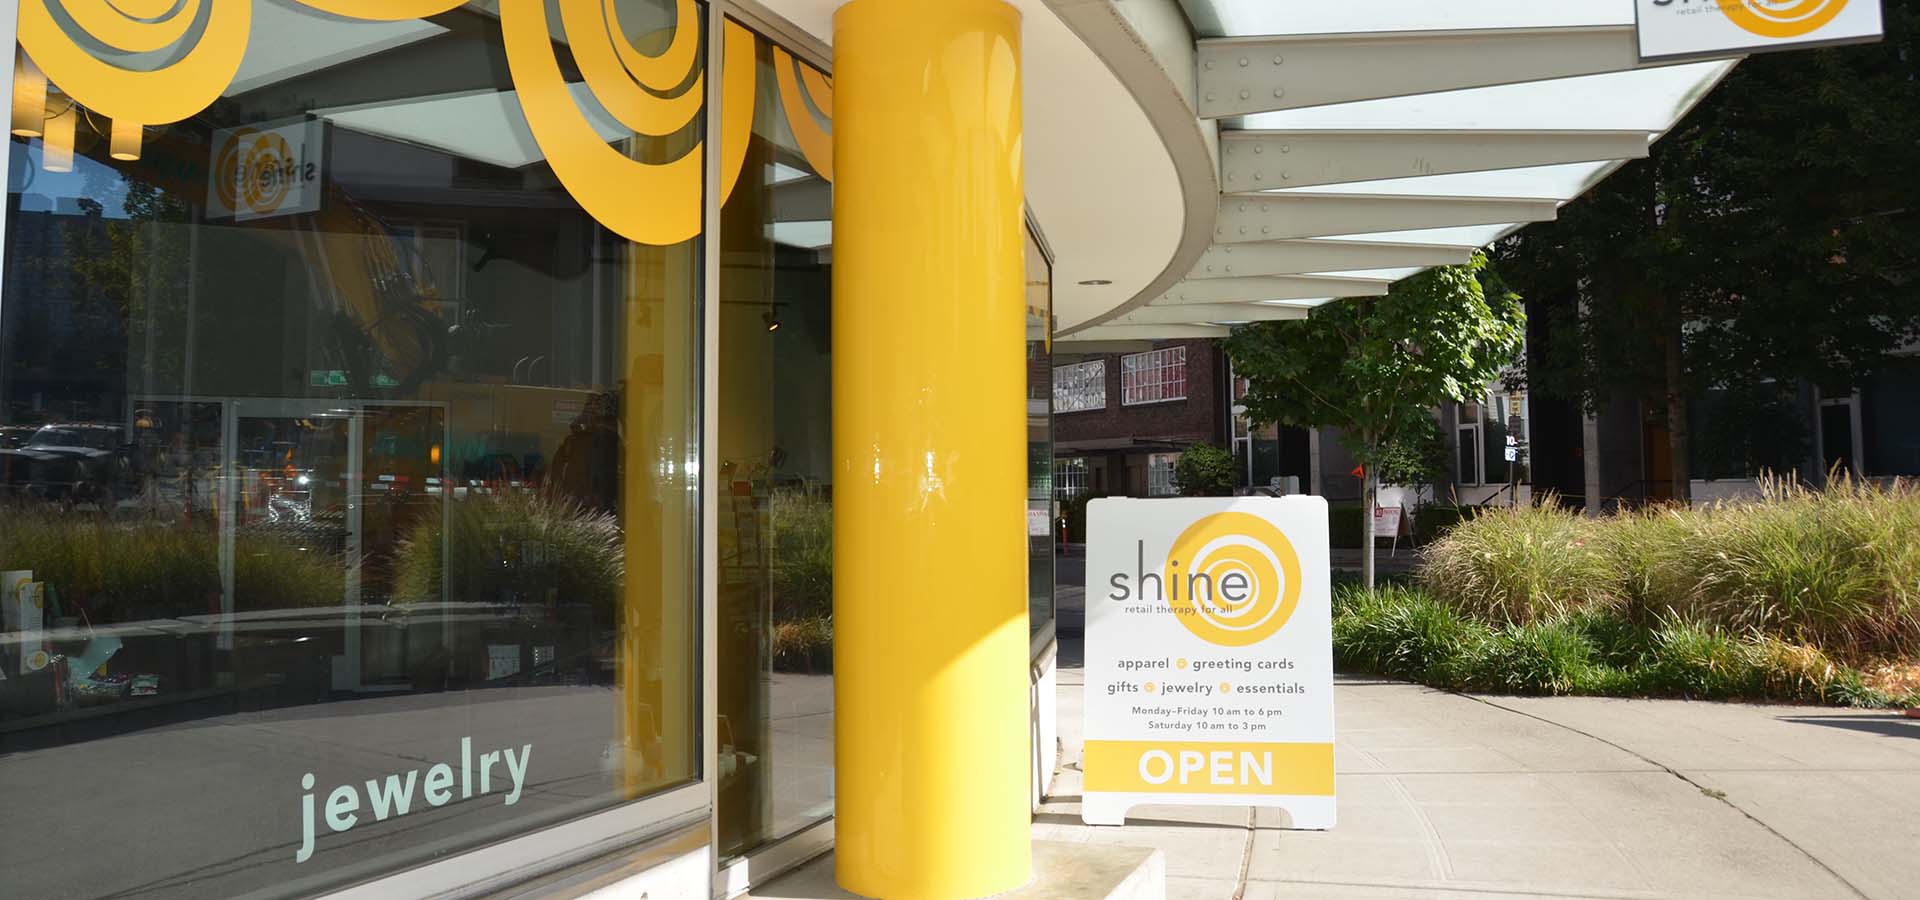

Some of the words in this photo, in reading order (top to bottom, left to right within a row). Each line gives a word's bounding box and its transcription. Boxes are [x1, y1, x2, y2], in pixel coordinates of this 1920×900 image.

[1109, 539, 1249, 602] shine
[1125, 604, 1153, 614] retail
[1156, 604, 1197, 616] therapy
[1201, 604, 1216, 614] for
[1219, 604, 1233, 614] all
[1117, 657, 1169, 673] apparel
[1192, 657, 1252, 673] greeting
[1257, 657, 1295, 670] cards
[1107, 681, 1139, 695] gifts
[1160, 681, 1213, 697] jewelry
[1236, 682, 1305, 695] essentials
[1212, 706, 1225, 716] 10
[1244, 708, 1255, 716] to
[1258, 707, 1265, 716] 6
[1266, 709, 1283, 718] pm
[1148, 721, 1193, 732] Saturday
[1196, 721, 1208, 730] 10
[1228, 722, 1239, 730] to
[1242, 721, 1249, 730] 3
[1250, 724, 1267, 732] pm
[1138, 749, 1273, 786] OPEN
[296, 736, 532, 864] jewelry
